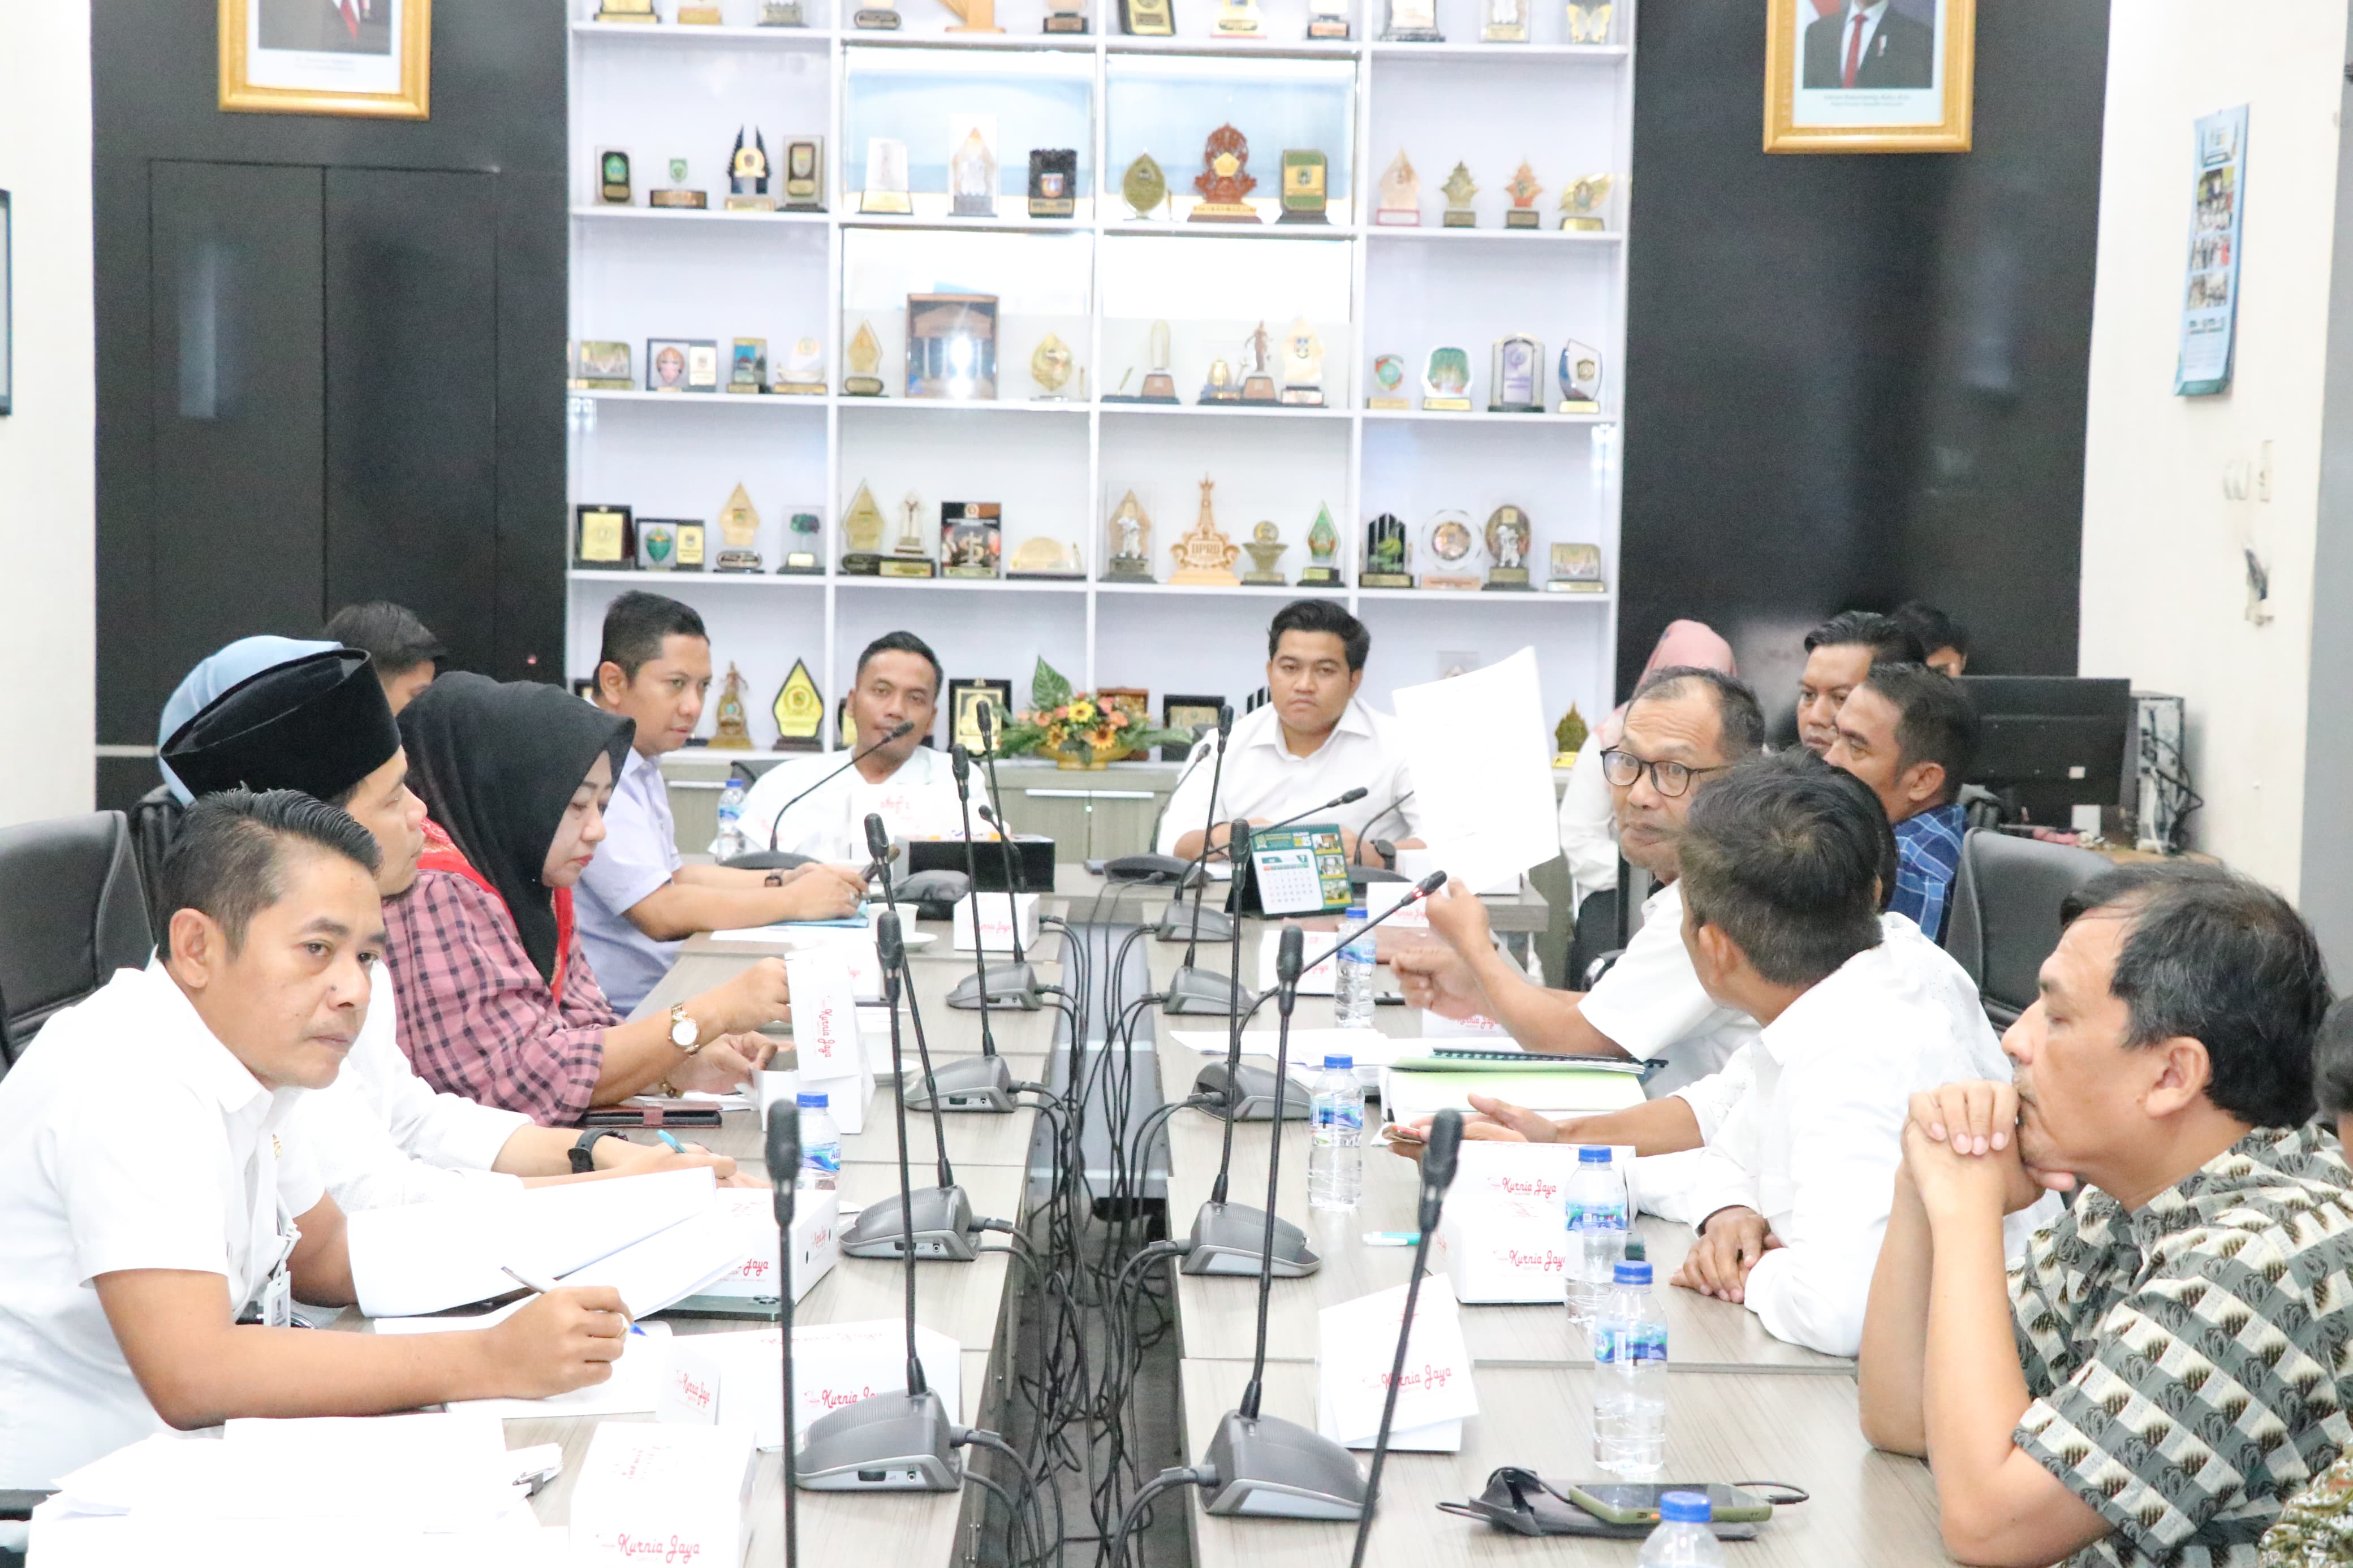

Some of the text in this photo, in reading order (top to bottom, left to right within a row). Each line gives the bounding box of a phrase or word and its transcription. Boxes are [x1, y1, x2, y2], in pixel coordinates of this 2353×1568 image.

[817, 1008, 835, 1058] Kurnia Jaya
[1502, 1177, 1557, 1199] Kurnia Jaya
[743, 1258, 769, 1277] Jaya
[1509, 1249, 1542, 1267] Kurnia
[1381, 1364, 1452, 1390] Krnia Jaya
[821, 1389, 858, 1409] Kurnia
[618, 1533, 700, 1564] Kurnia Jaya
